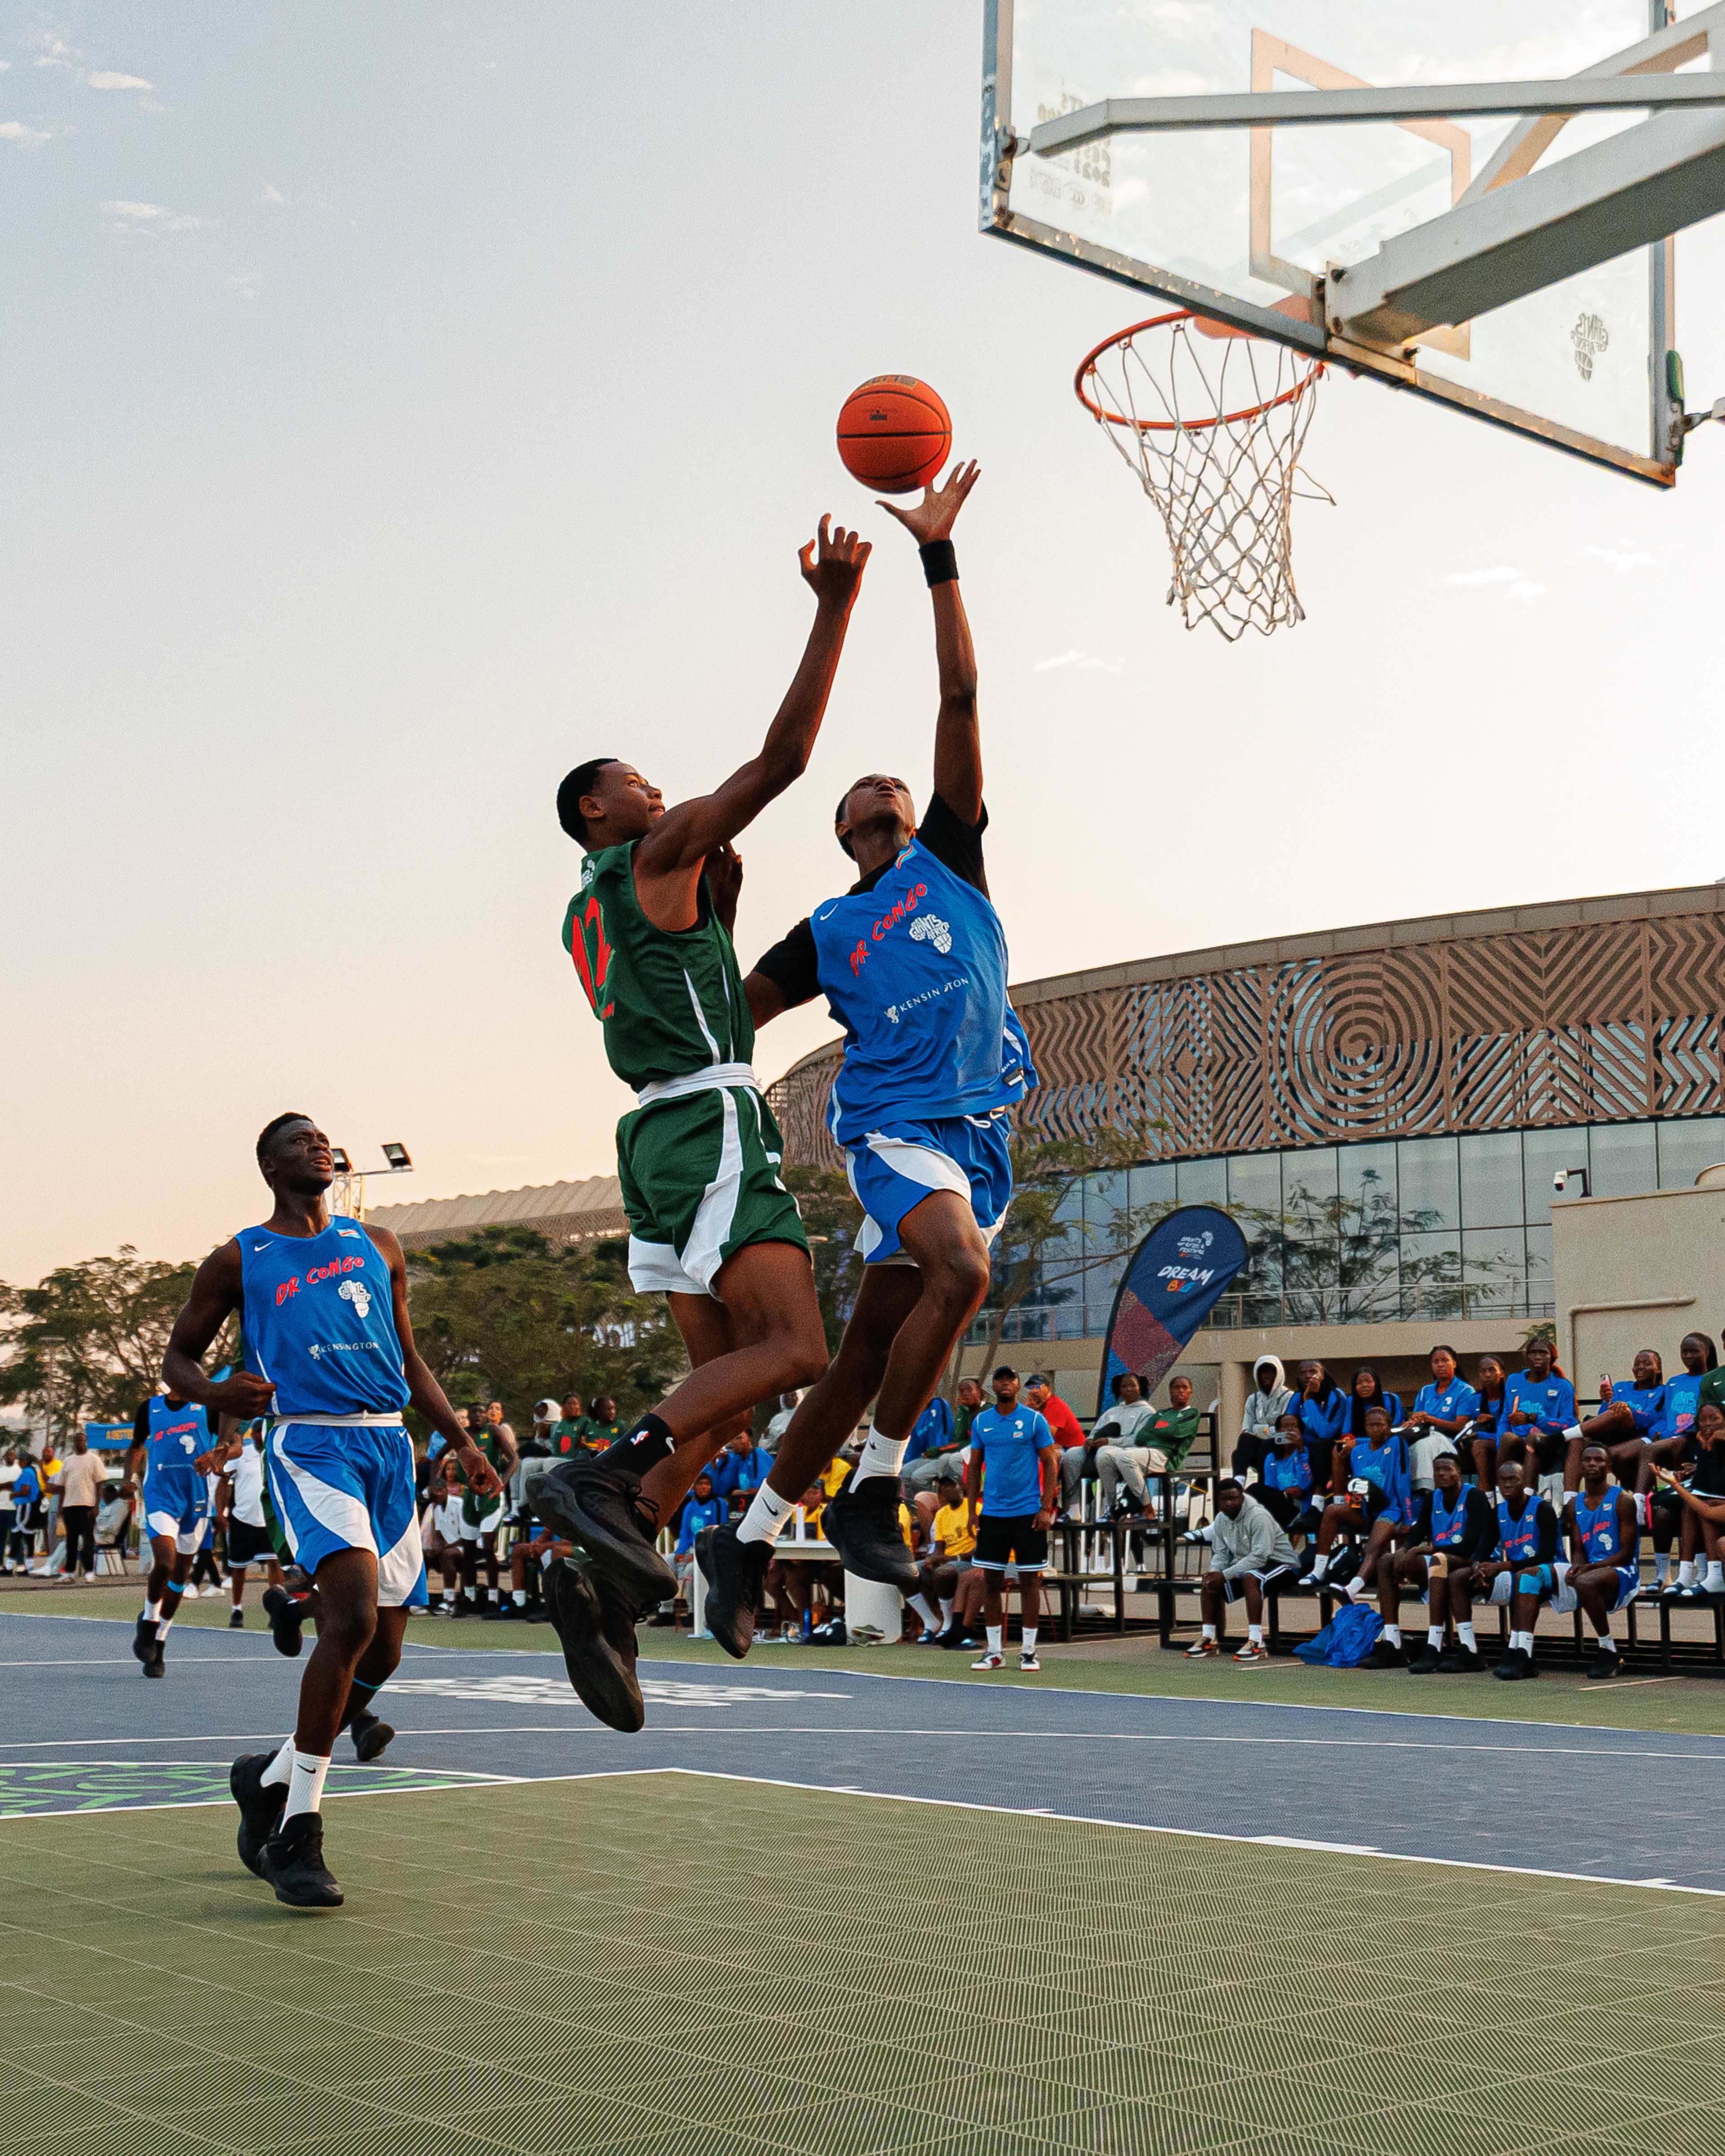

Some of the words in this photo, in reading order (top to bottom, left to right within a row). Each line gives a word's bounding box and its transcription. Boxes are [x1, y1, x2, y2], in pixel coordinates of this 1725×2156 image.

[850, 940, 869, 978] DR
[872, 883, 928, 941] CONGO
[909, 914, 942, 937] GIANTS
[927, 922, 950, 941] AFRICA
[276, 1276, 300, 1307] DR
[306, 1256, 365, 1285] CONGO
[1158, 1265, 1215, 1286] DREAM
[1167, 1279, 1195, 1292] BIG
[321, 1342, 379, 1353] KENSINGTON
